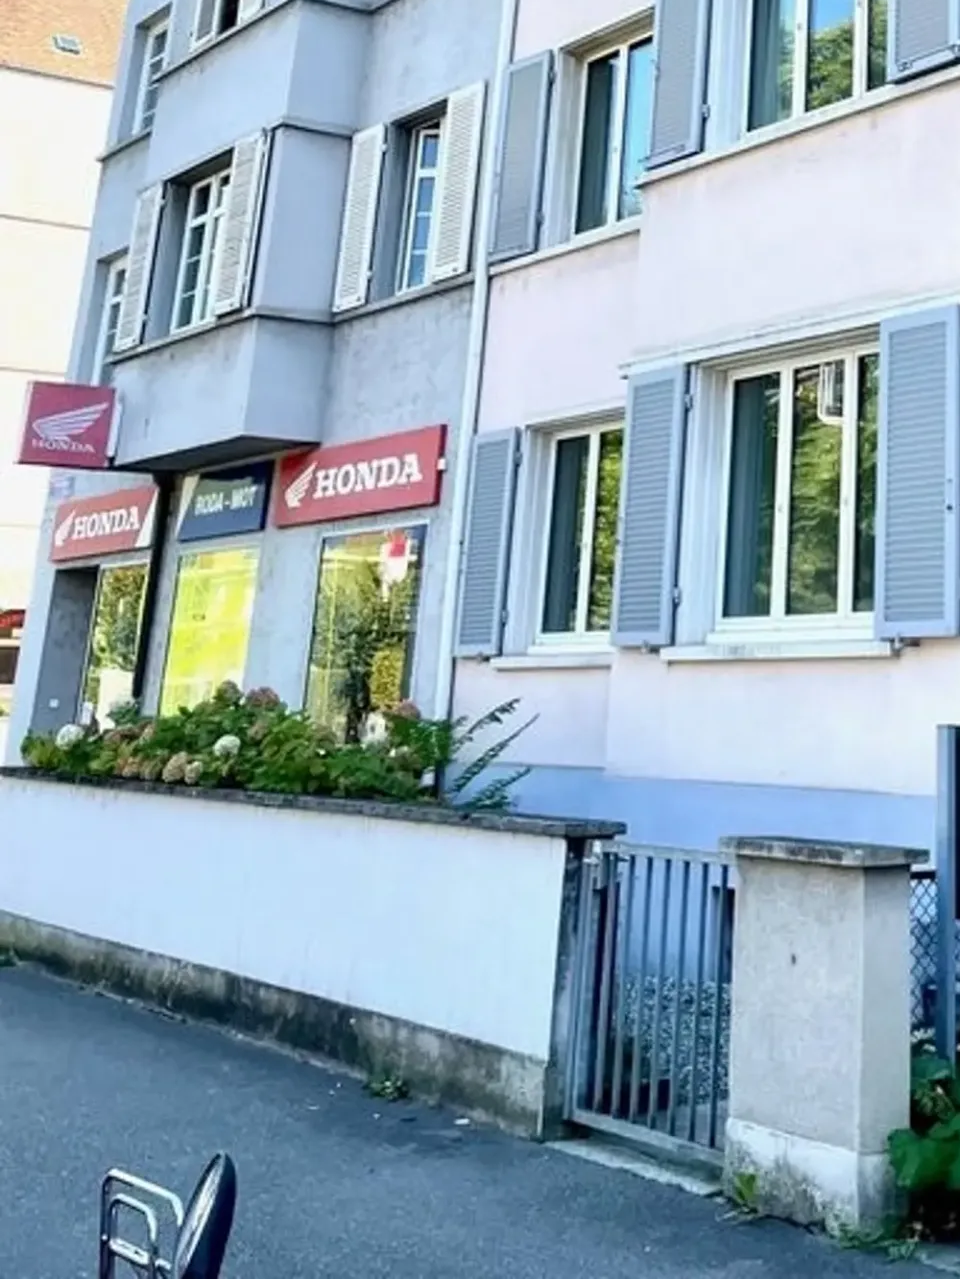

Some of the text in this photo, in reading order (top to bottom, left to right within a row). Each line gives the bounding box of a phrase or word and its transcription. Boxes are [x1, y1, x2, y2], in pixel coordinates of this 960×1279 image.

[31, 438, 96, 453] HONDA
[312, 453, 423, 500] HONDA
[71, 506, 140, 540] HONDA
